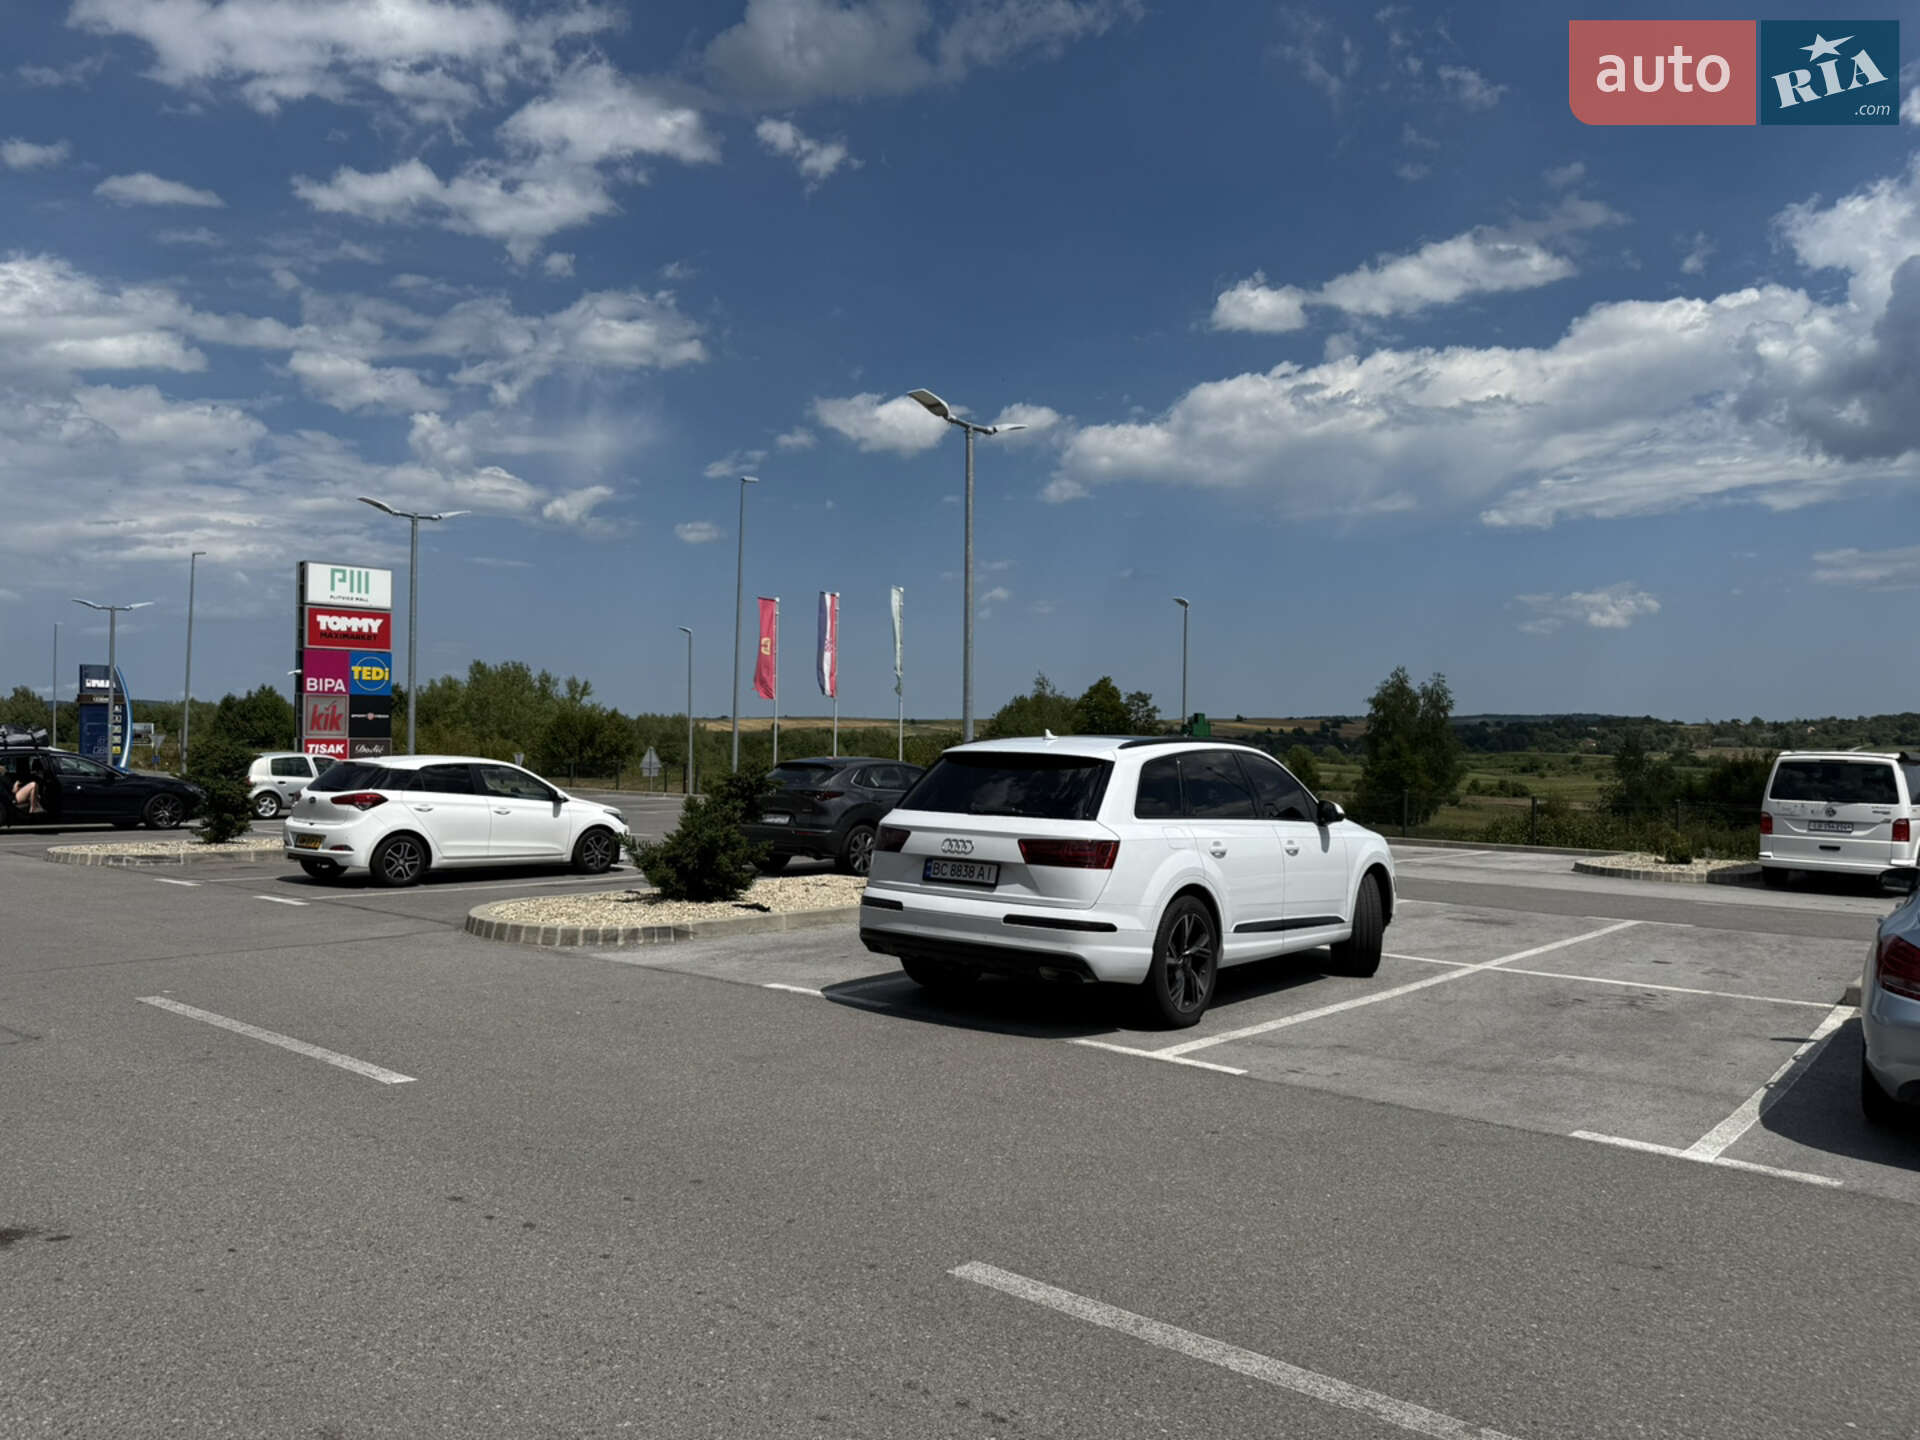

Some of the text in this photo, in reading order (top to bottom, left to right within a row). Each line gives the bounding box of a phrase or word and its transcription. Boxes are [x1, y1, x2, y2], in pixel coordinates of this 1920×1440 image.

[316, 615, 383, 633] TOMMY
[320, 632, 379, 641] MAXIMARKET
[352, 666, 390, 681] TEDi
[306, 677, 346, 692] BIPA
[307, 743, 345, 755] TISAK
[932, 862, 948, 876] BC
[950, 864, 975, 879] 8838
